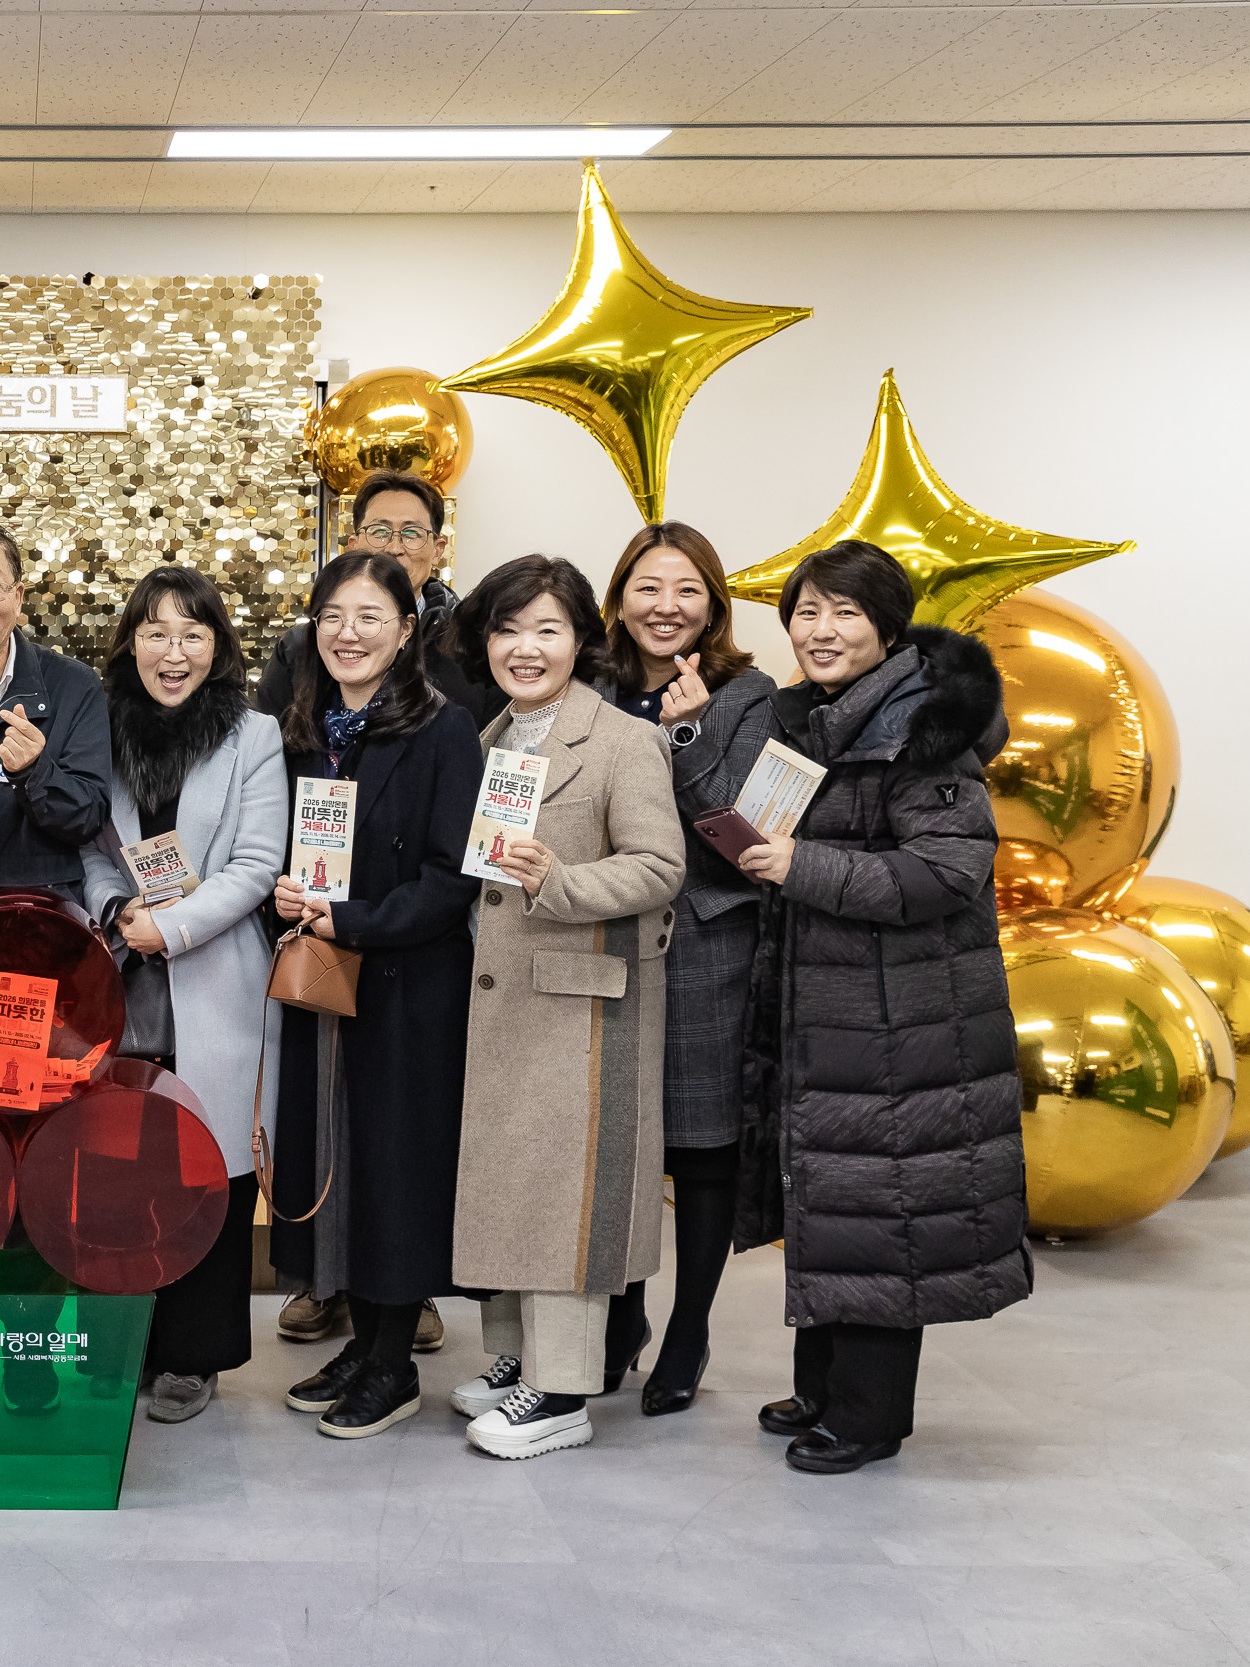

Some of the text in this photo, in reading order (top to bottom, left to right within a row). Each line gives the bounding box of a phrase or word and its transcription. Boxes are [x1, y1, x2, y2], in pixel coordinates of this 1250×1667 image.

[70, 383, 103, 419] 날
[492, 770, 509, 778] 2026
[488, 778, 535, 799] 따뜻한
[486, 792, 531, 810] 겨울나기
[302, 807, 348, 823] 따뜻한
[301, 821, 345, 833] 겨울나기
[136, 852, 180, 872] 따뜻한
[141, 860, 183, 879] 겨울나기
[0, 994, 16, 1002] 2026
[47, 1332, 88, 1352] 열매
